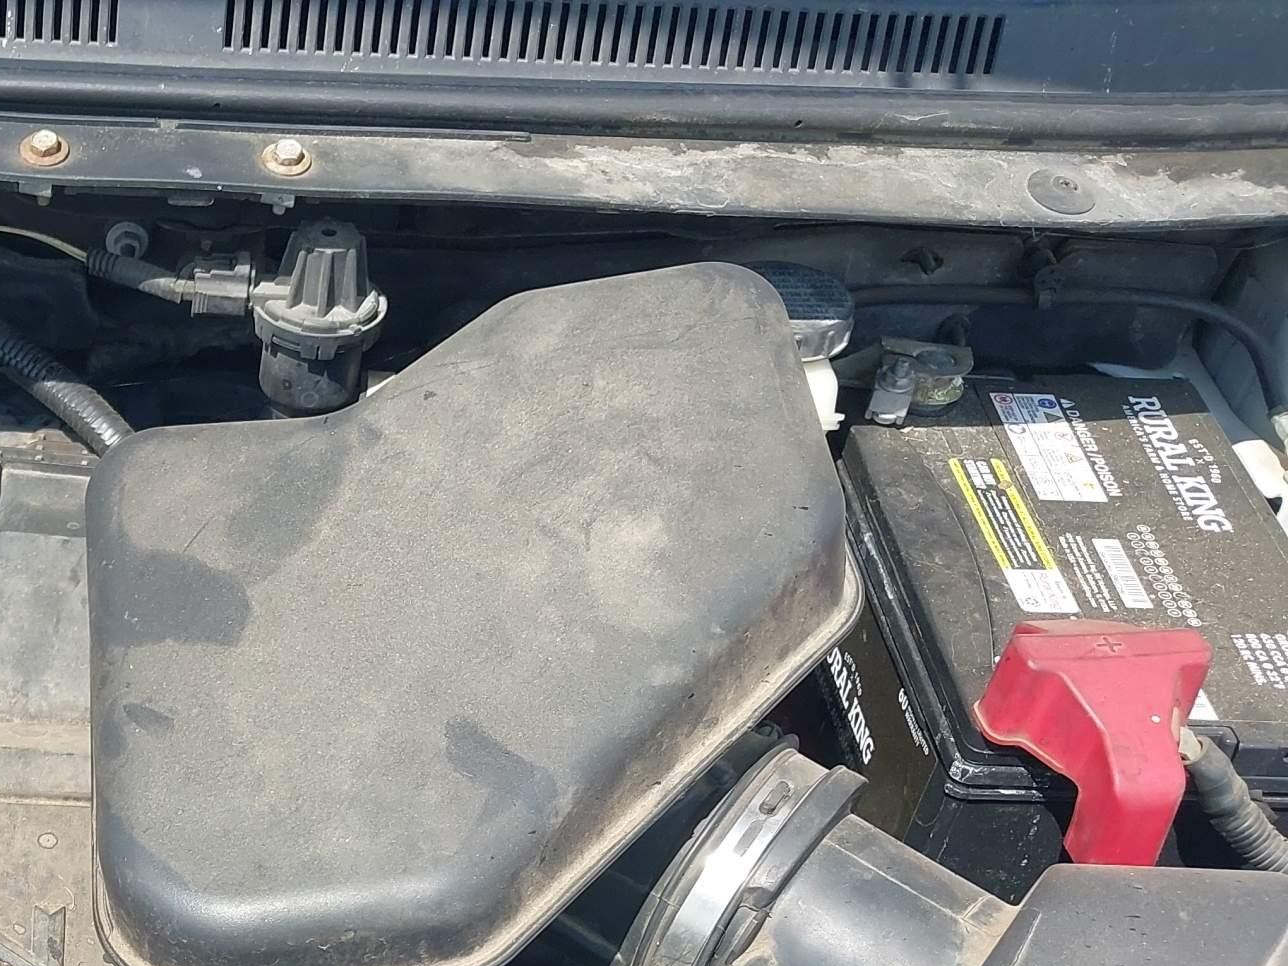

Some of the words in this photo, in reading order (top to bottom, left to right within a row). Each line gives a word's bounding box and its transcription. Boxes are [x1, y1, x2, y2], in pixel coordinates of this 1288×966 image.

[1121, 405, 1149, 443] AMERICA'S
[1142, 444, 1159, 463] FARM
[1158, 472, 1177, 494] HOME
[1171, 496, 1192, 520] STORE
[1127, 396, 1195, 472] RURAL
[1172, 476, 1231, 535] KING
[1230, 634, 1247, 649] 120
[1255, 650, 1269, 662] CA
[1270, 651, 1287, 667] CCA
[898, 687, 909, 711] 60
[847, 696, 875, 765] KING
